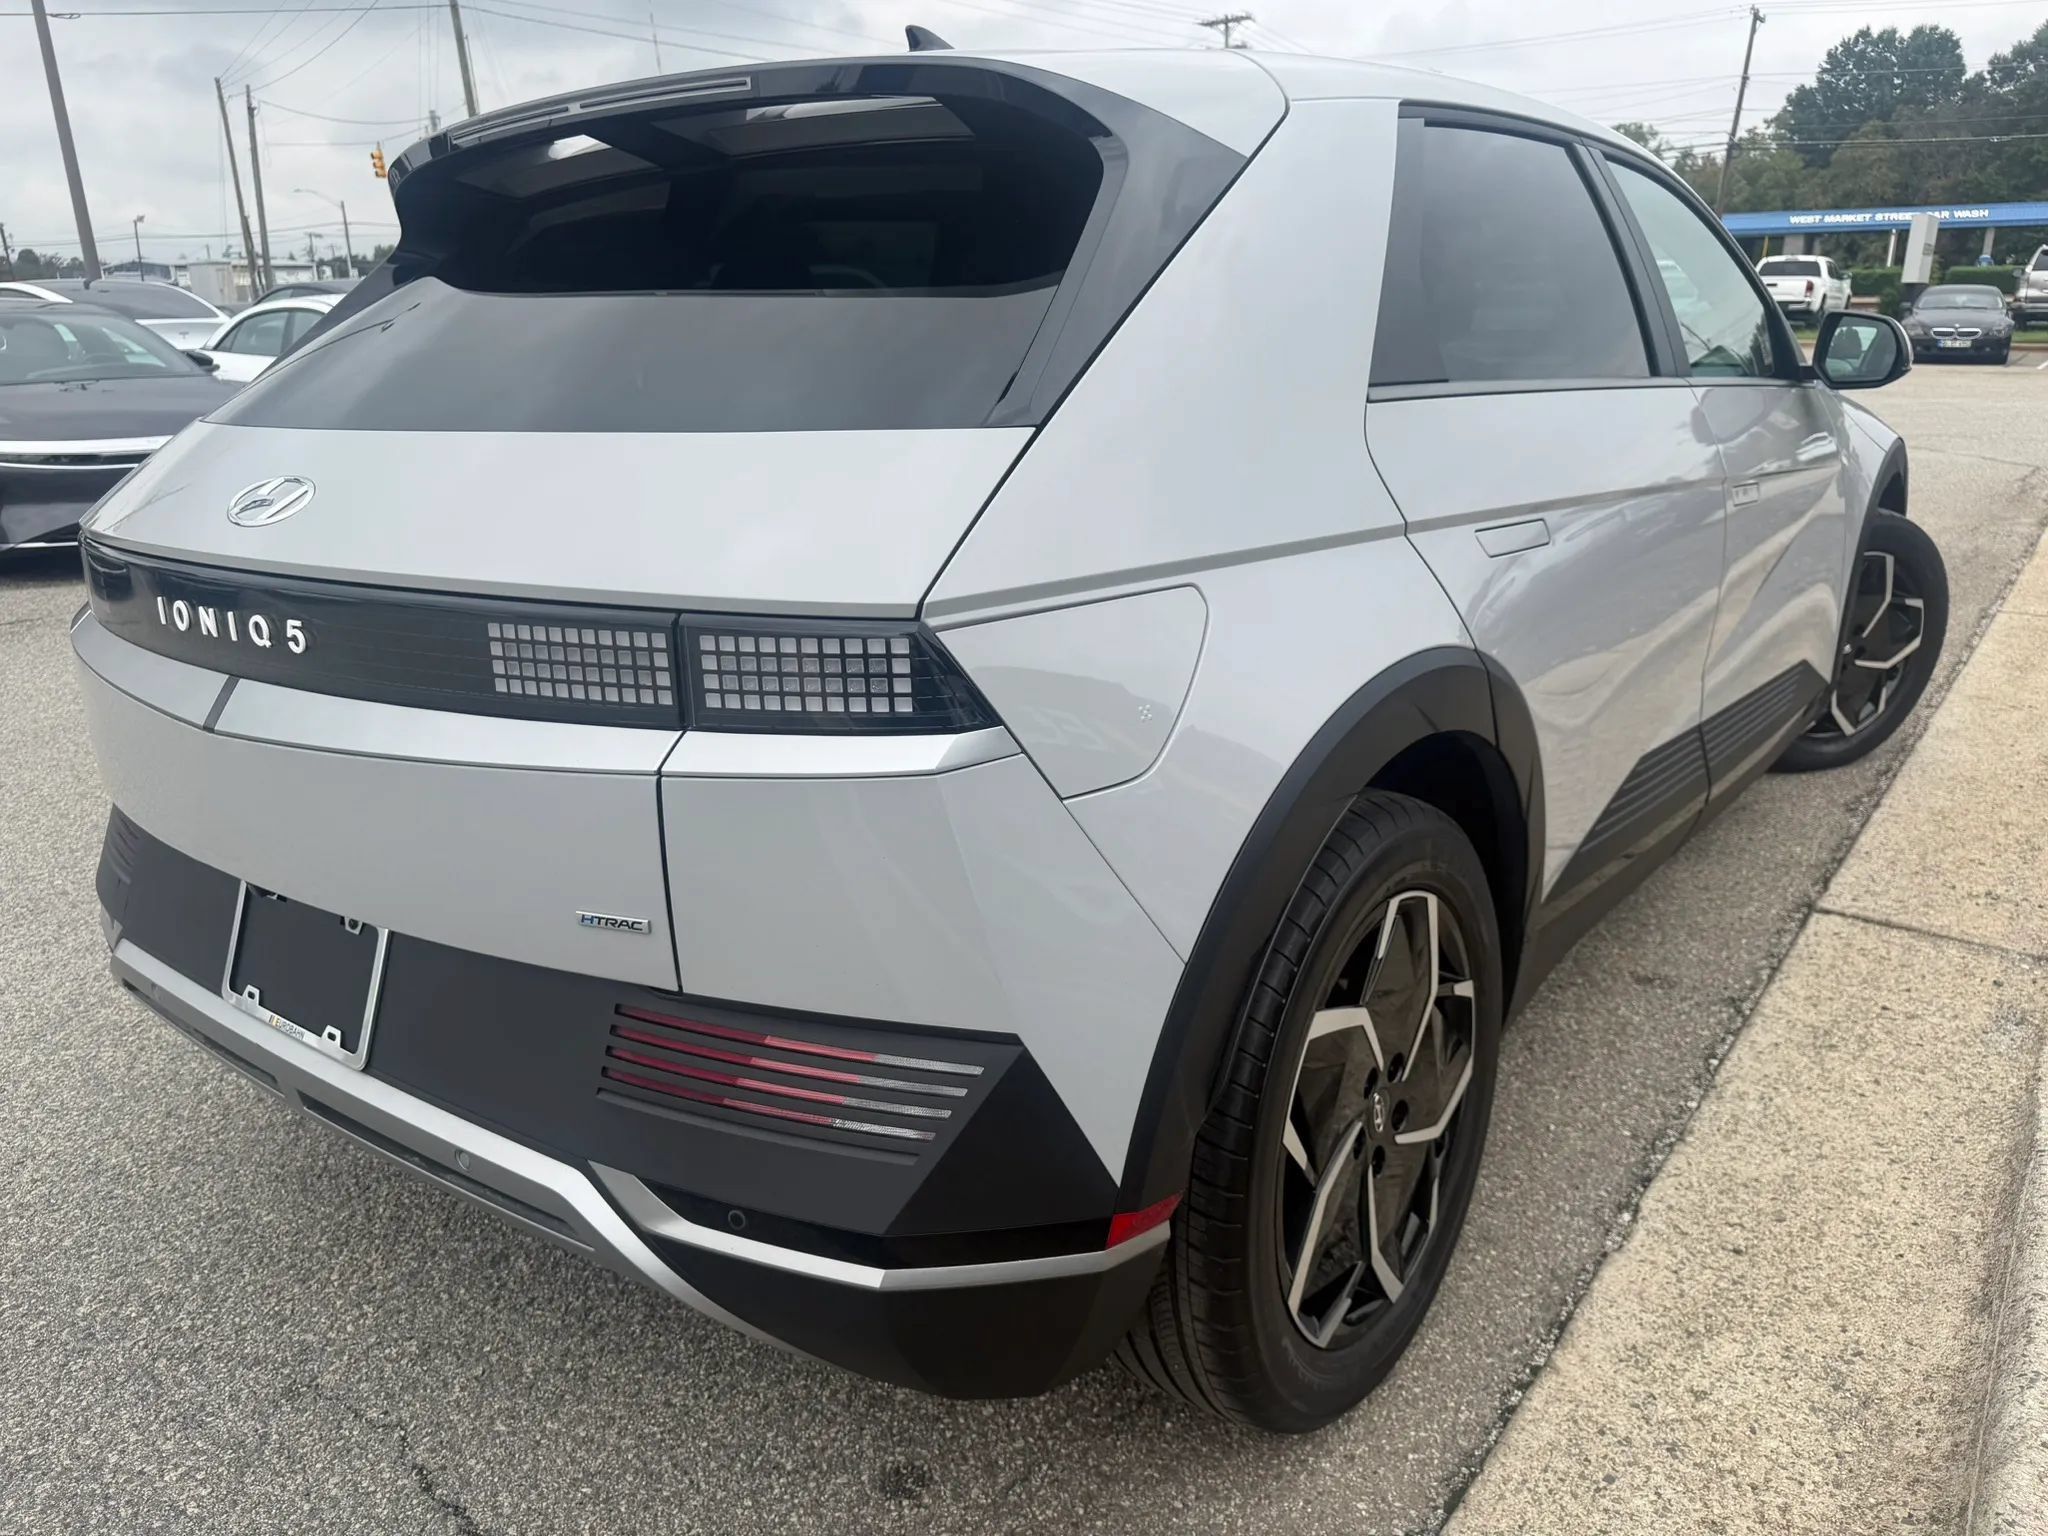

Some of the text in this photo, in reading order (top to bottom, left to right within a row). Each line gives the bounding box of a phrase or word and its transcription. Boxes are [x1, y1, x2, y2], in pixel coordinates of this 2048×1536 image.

[1790, 215, 1822, 224] WEST
[1824, 213, 1872, 223] MARKET
[1874, 212, 1921, 221] STREE
[1953, 208, 1989, 218] WASH
[156, 596, 307, 654] IONIQ 5
[581, 914, 643, 931] HTRAC
